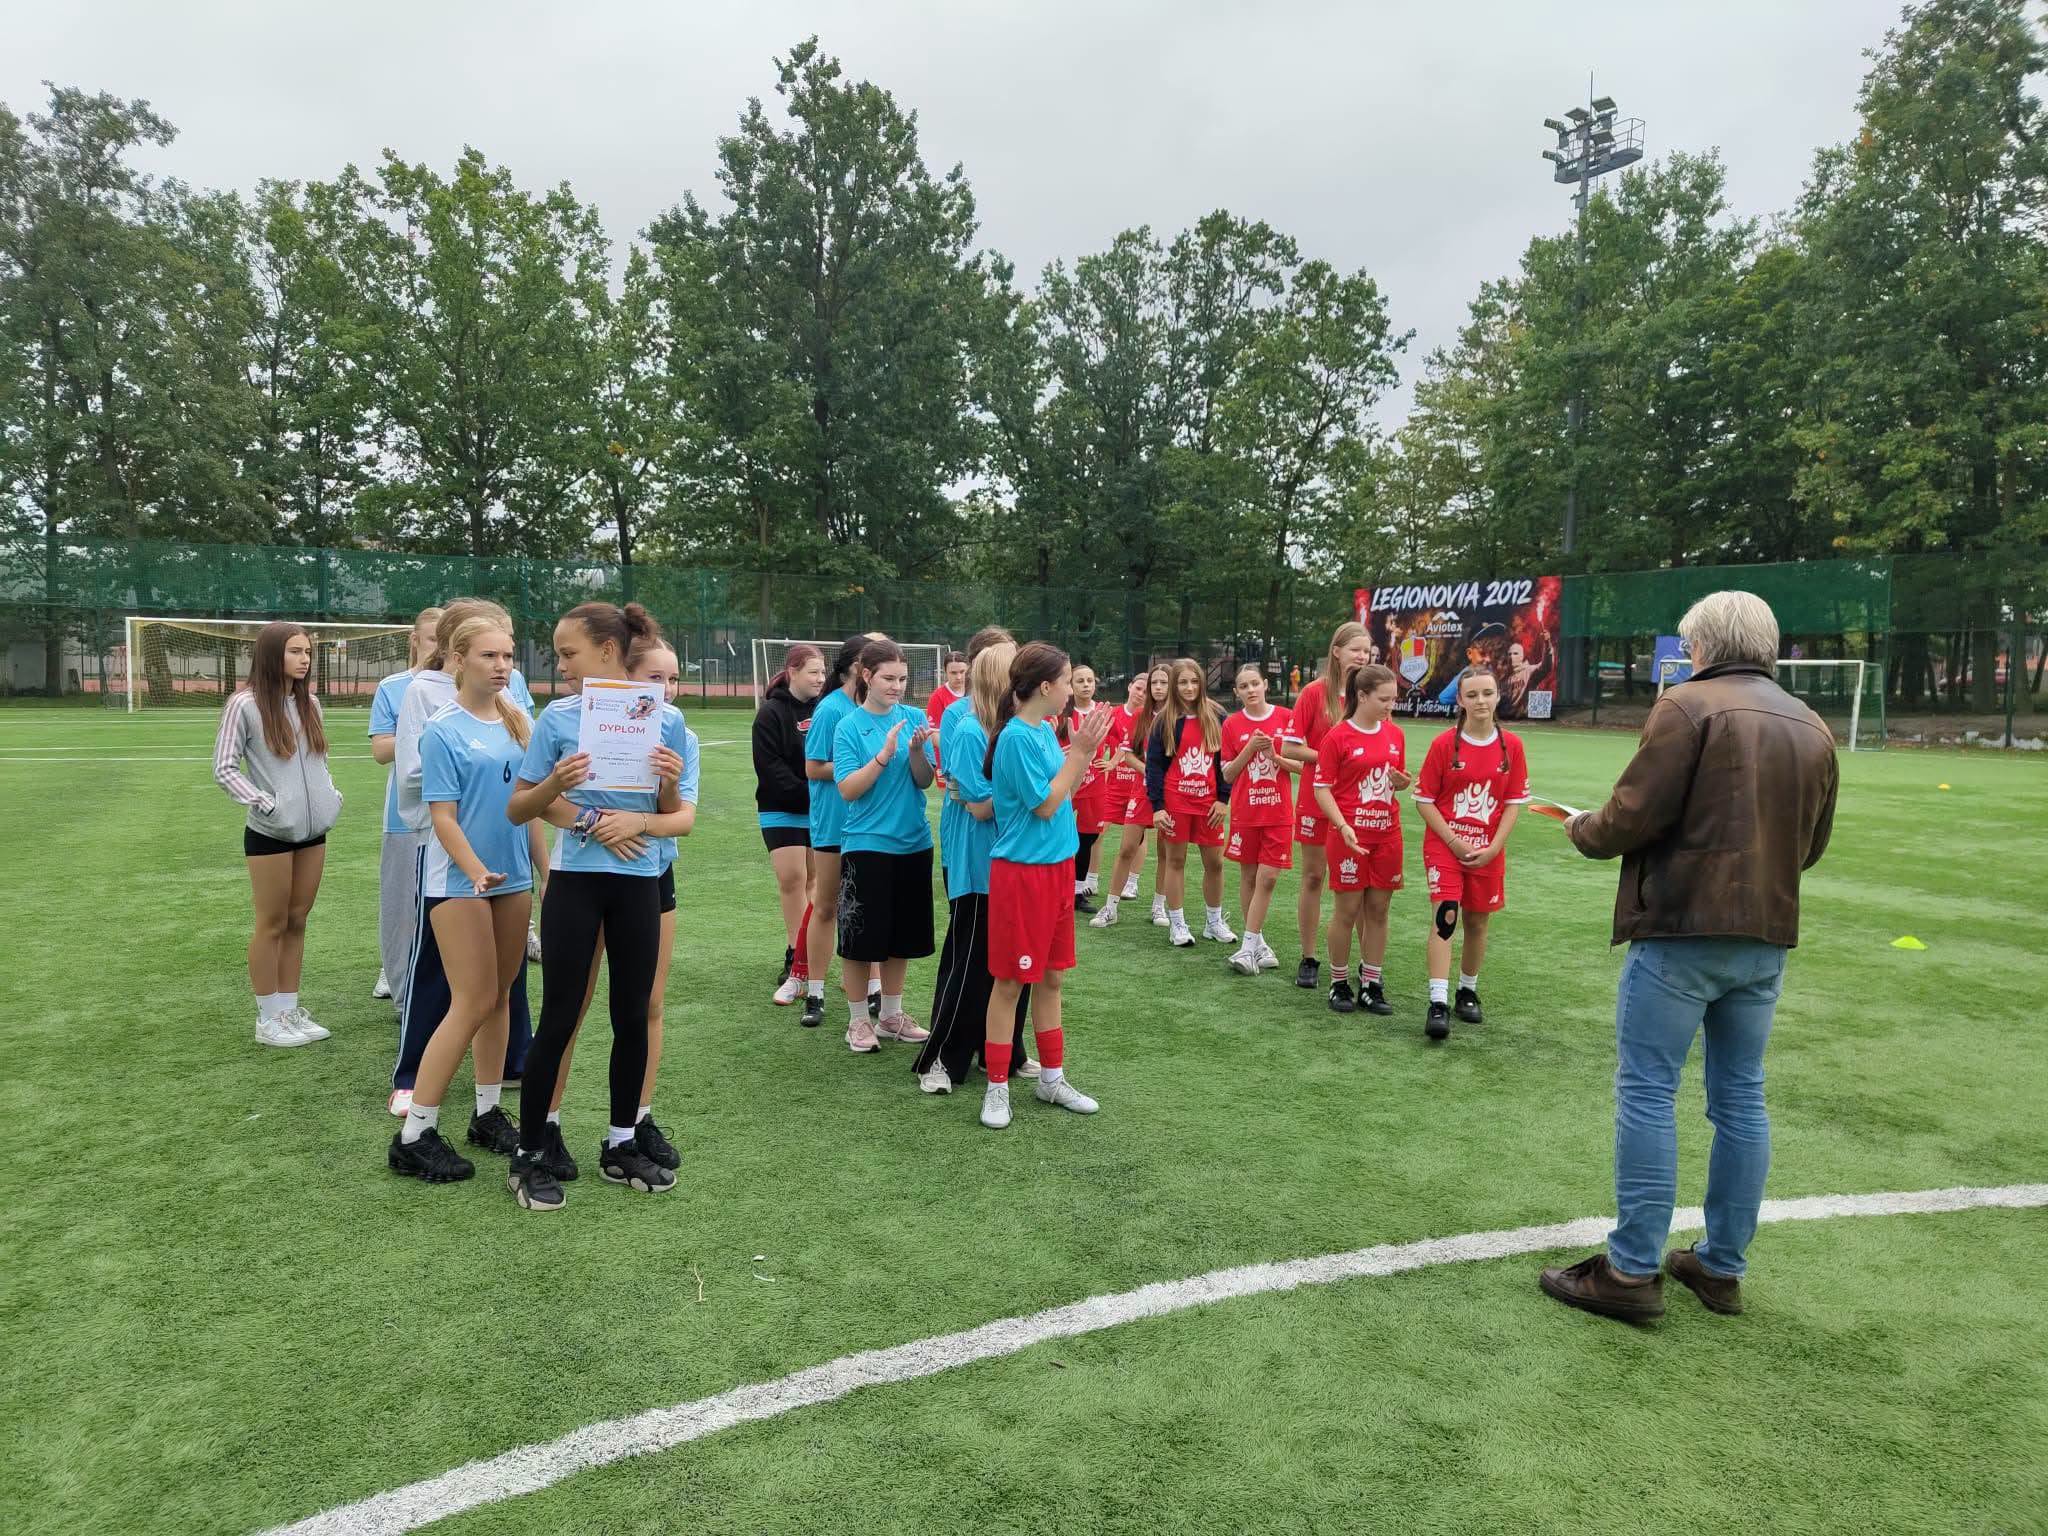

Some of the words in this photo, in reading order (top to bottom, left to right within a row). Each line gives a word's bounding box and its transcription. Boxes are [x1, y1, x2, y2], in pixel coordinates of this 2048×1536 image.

[1370, 582, 1481, 612] LEGIONOVIA
[1483, 579, 1533, 607] 2012
[1426, 621, 1463, 633] Aviotex
[1392, 697, 1414, 712] anek
[599, 723, 646, 735] DYPLOM
[503, 760, 512, 784] 6
[1249, 792, 1282, 806] Energii
[1355, 807, 1389, 818] Drużyna
[1354, 816, 1392, 830] Energii
[1448, 821, 1485, 834] Drużyna
[1455, 833, 1490, 849] nergii
[1019, 955, 1032, 970] 9
